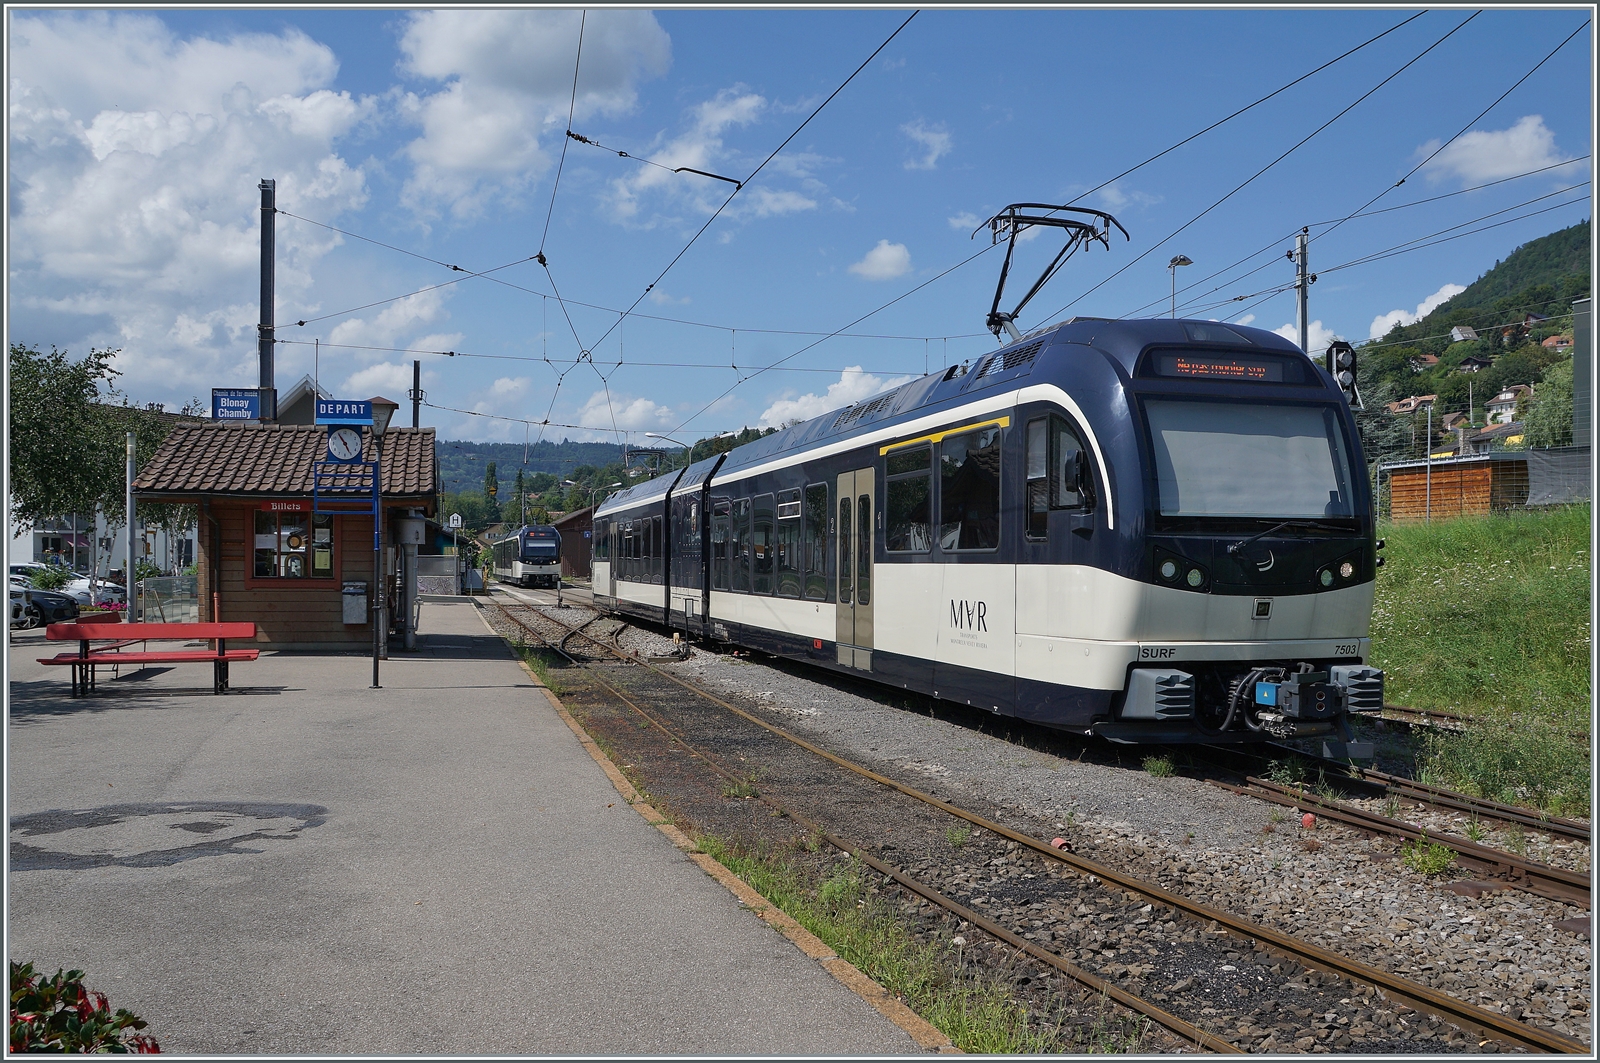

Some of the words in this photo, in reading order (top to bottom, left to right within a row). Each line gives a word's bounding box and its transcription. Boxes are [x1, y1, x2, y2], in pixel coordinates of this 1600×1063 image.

[220, 397, 249, 408] Blonay
[218, 408, 252, 419] Chamby
[320, 403, 365, 414] DEPART
[270, 502, 301, 510] Billets
[452, 516, 459, 525] H
[830, 517, 835, 534] 2
[1141, 648, 1176, 659] SURF
[1334, 644, 1357, 655] 7503
